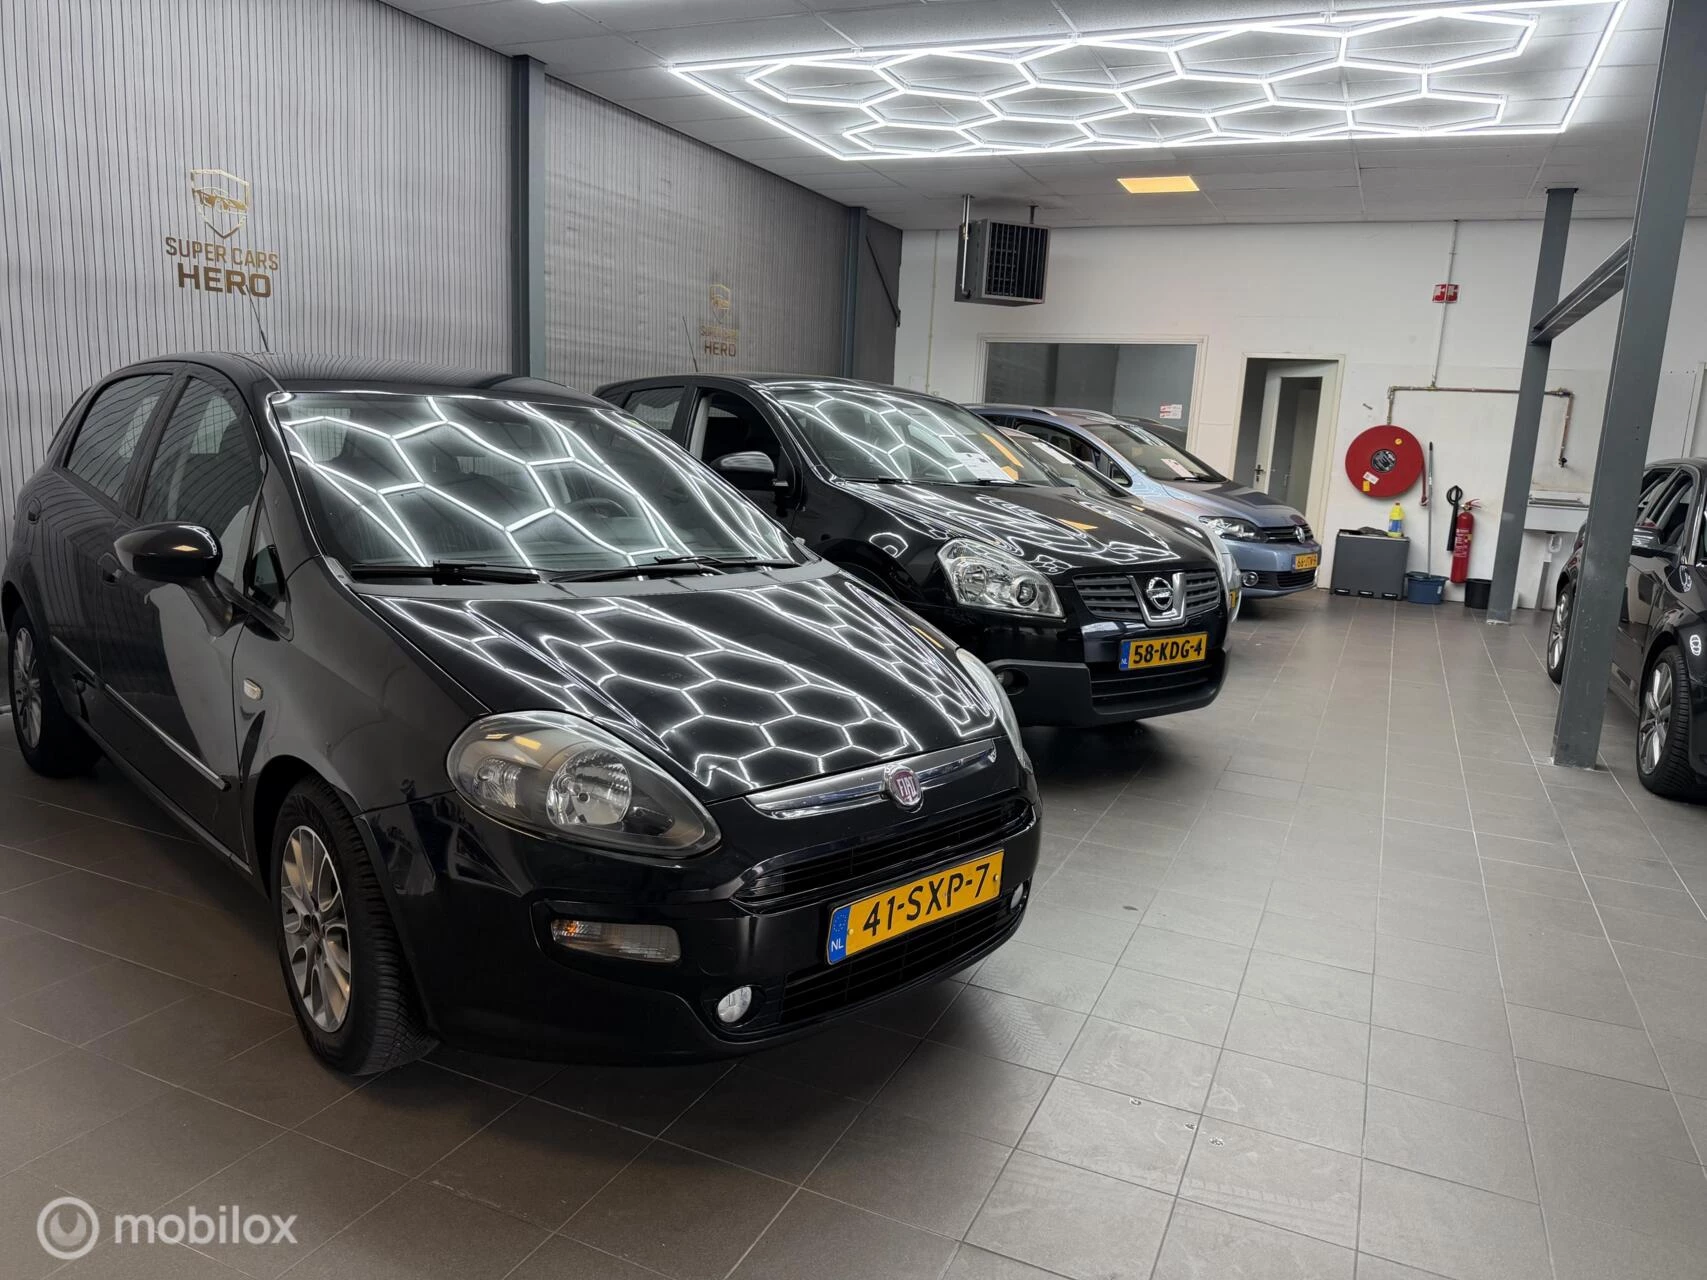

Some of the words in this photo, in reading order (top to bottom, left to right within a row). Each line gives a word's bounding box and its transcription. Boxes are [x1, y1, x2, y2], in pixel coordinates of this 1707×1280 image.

[165, 236, 227, 263] SUPER
[232, 247, 279, 271] CARS
[177, 262, 272, 298] HERO
[704, 340, 737, 357] HERO
[1133, 638, 1203, 664] 58-KDG-4
[831, 939, 844, 952] NL
[862, 862, 991, 937] 41-SXP-7
